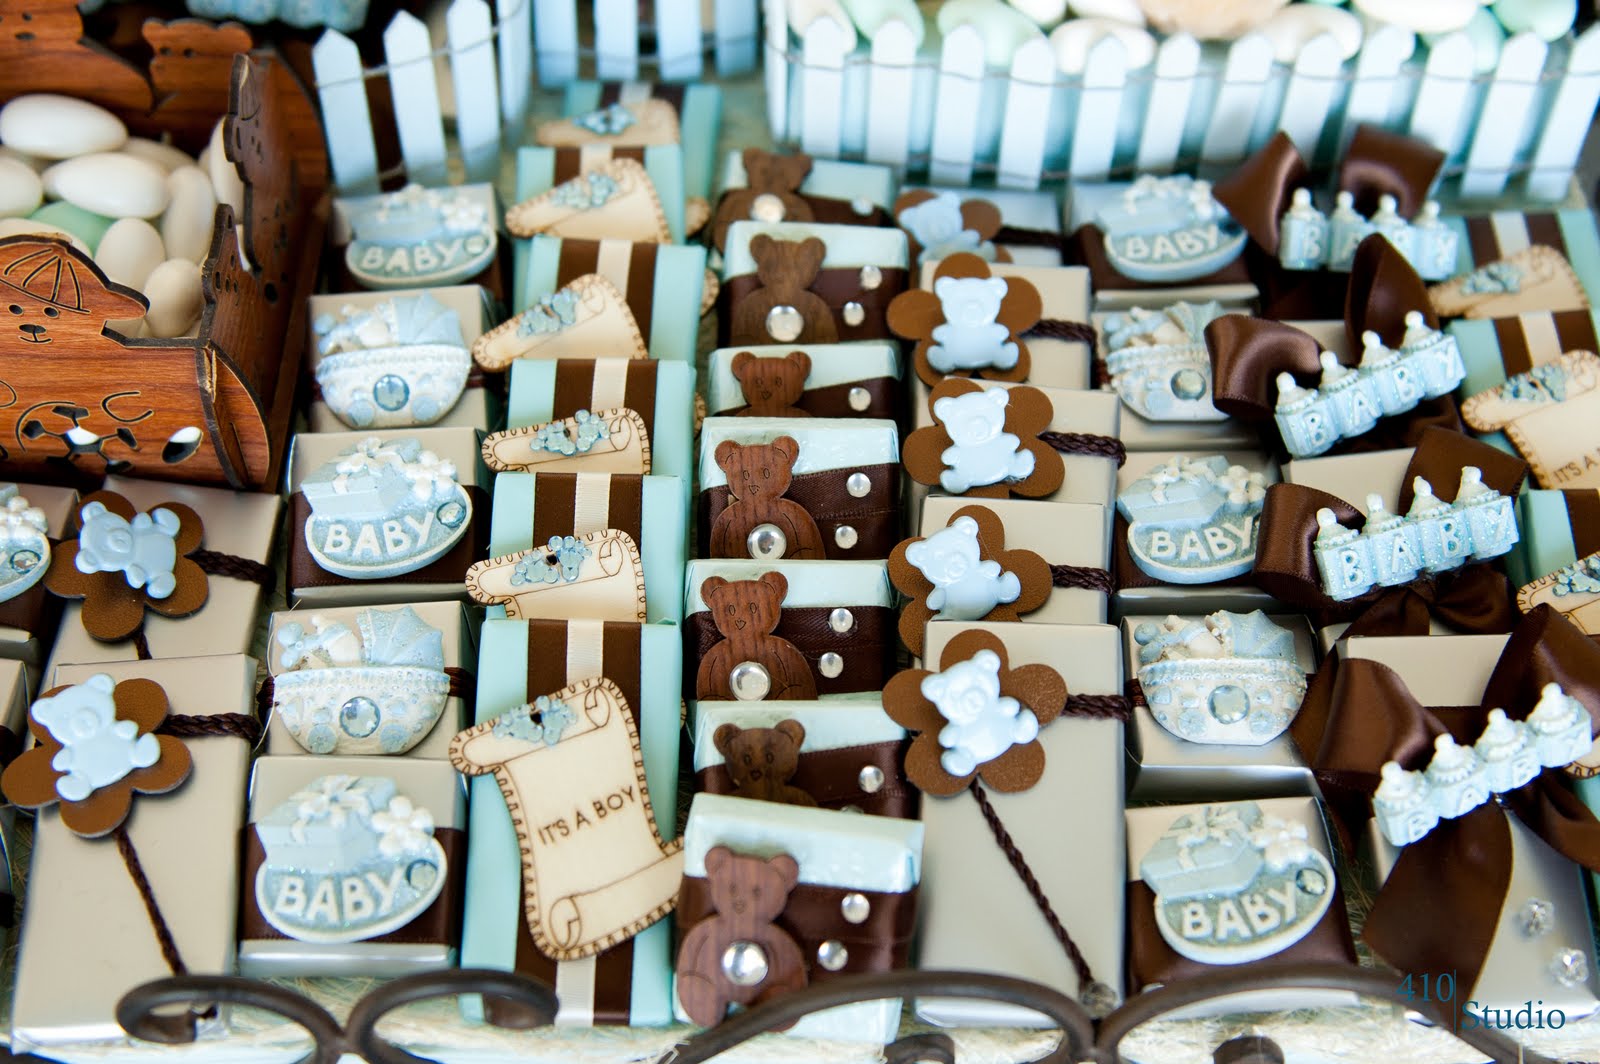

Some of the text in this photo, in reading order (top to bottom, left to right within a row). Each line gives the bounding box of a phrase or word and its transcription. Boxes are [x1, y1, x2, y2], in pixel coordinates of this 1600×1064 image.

[361, 238, 464, 272] BABY
[1126, 224, 1219, 261] BABY
[1304, 343, 1456, 447] BABY
[1553, 455, 1599, 483] IT'S A
[324, 511, 434, 557] BABY
[1150, 516, 1254, 562] BABY
[1340, 504, 1508, 588] BABY
[537, 785, 636, 845] IT'S A BOY
[274, 867, 402, 925] BABY
[1182, 881, 1298, 941] BABY
